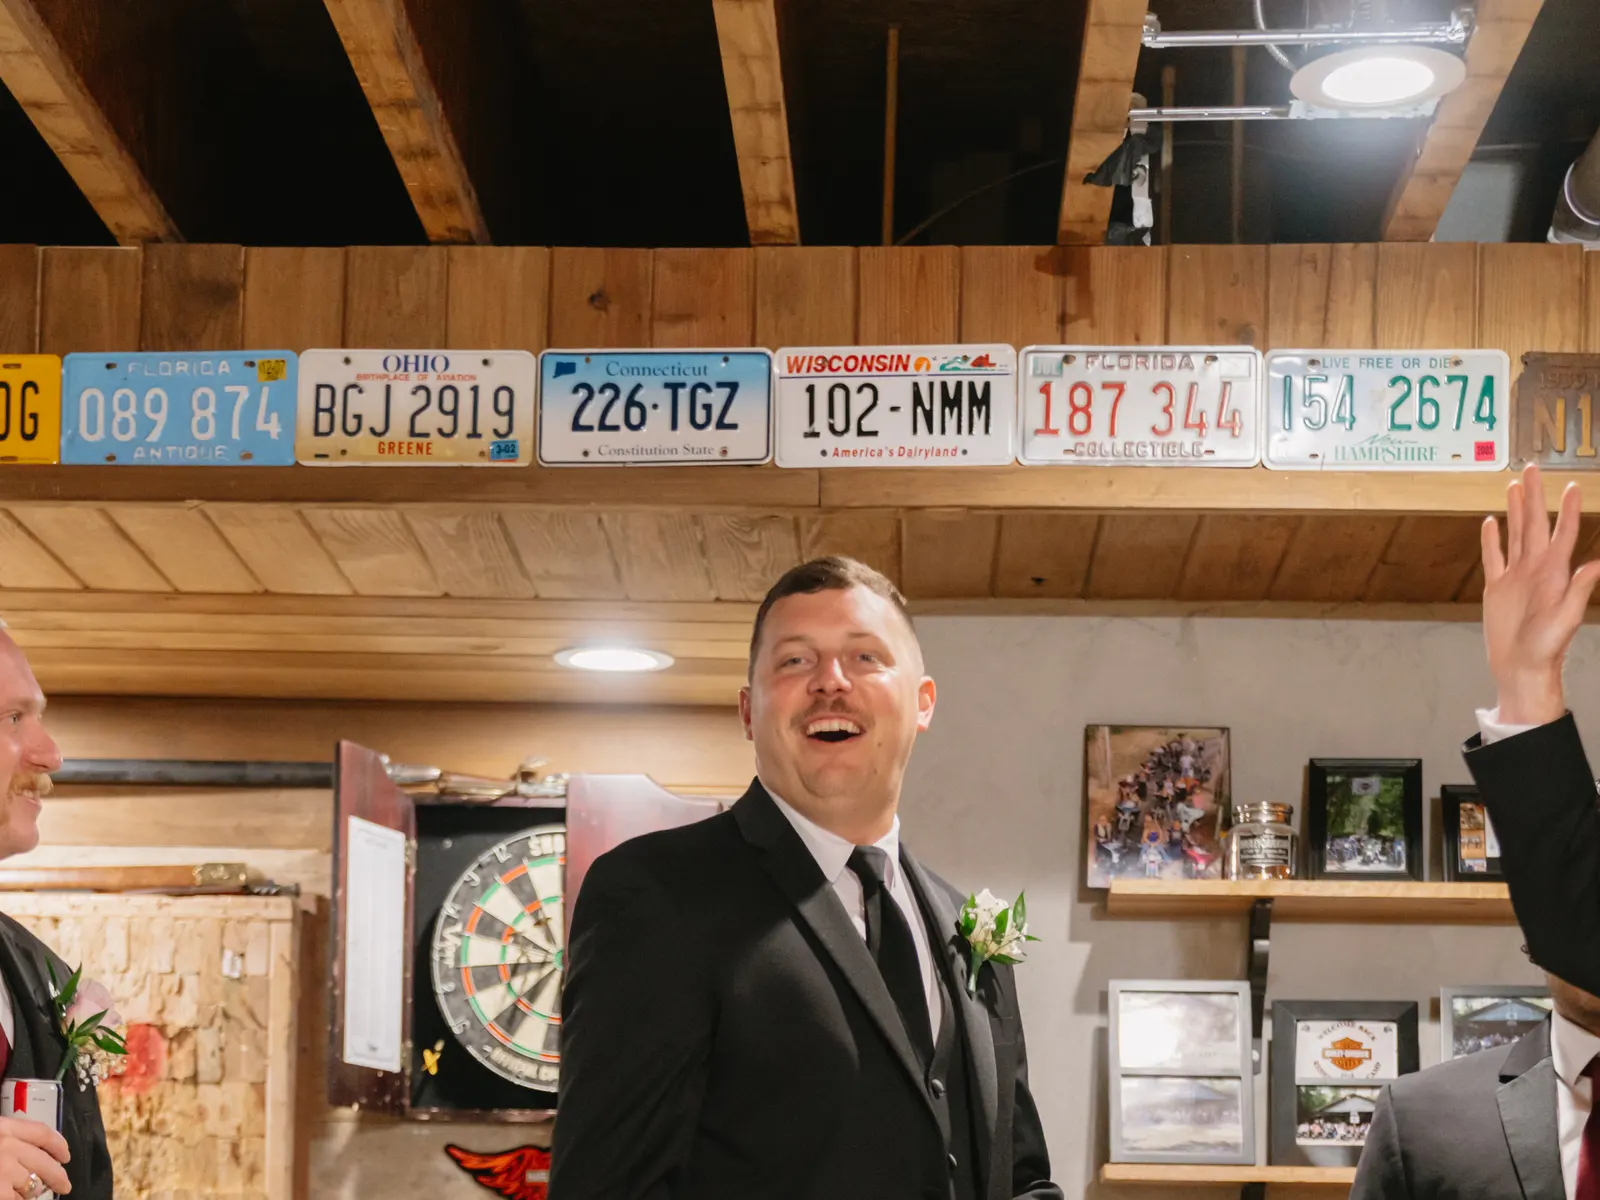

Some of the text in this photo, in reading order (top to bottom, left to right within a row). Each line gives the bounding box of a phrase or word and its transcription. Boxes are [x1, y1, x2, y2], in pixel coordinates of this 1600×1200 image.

[127, 360, 233, 377] FLORIDA
[382, 354, 450, 373] OHIO
[605, 360, 709, 377] Connecticut
[787, 354, 911, 374] WISCONSIN
[1085, 354, 1195, 371] FLORIDA
[1322, 357, 1450, 369] LIVE FREE OR DIE
[356, 373, 478, 382] BIRTHPLACE OF AVIATION
[313, 384, 516, 439] BGJ 2919
[1034, 381, 1243, 438] 187 344
[1283, 375, 1497, 431] 154 2674
[78, 385, 282, 442] 089 874
[132, 445, 229, 461] ANTIQUE
[378, 441, 433, 455] GREENE
[597, 443, 715, 457] Constitution State
[832, 446, 959, 460] America's Dairyland
[1074, 441, 1204, 458] COLLECTIBLE
[1334, 446, 1438, 464] HAMPSHIRE
